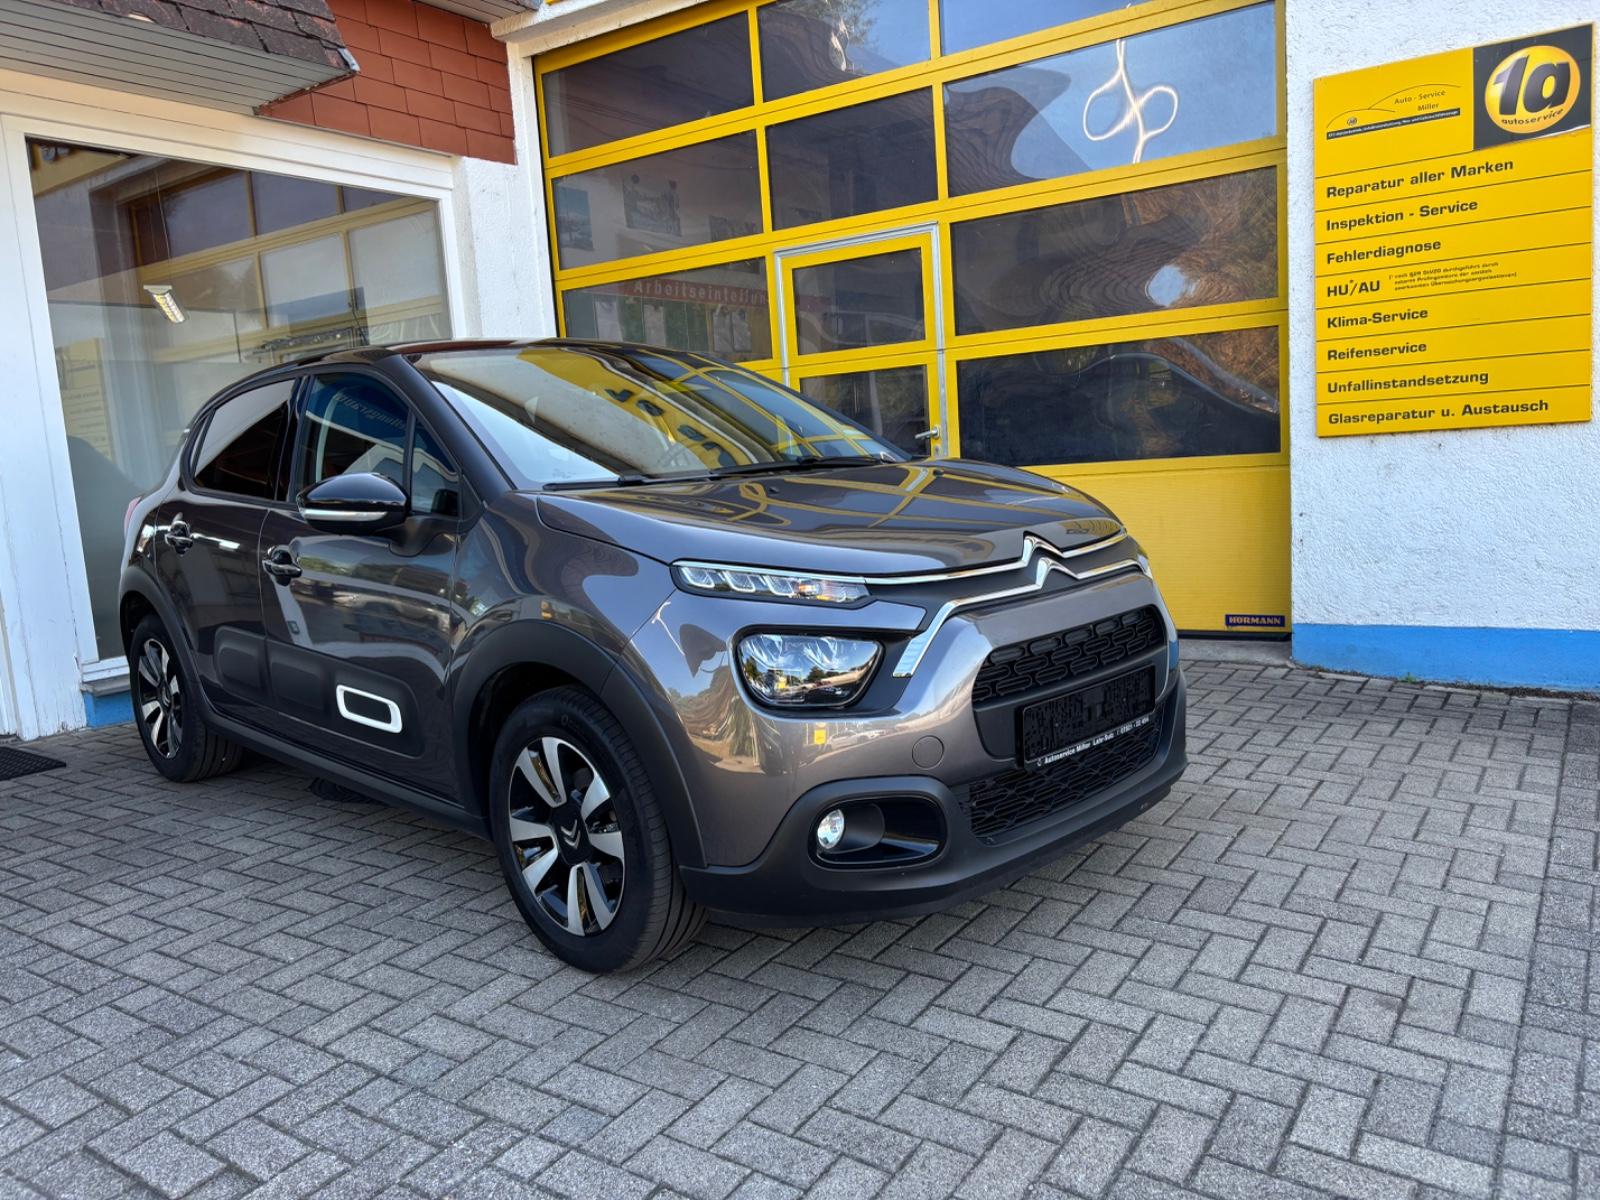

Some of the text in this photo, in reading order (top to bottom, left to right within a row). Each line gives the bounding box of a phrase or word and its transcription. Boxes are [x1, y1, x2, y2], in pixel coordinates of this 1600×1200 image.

[1394, 96, 1413, 105] Auto
[1418, 89, 1446, 101] Service
[1417, 102, 1440, 112] Miller
[1501, 107, 1565, 126] autoservice
[1326, 159, 1514, 199] Reparatur aller Marken
[1326, 210, 1404, 231] Inspektion
[1419, 200, 1478, 218] Service
[1327, 240, 1442, 265] Fehlerdiagnose
[633, 278, 768, 306] Arbeitseinteilun
[1327, 308, 1428, 329] Klima-Service
[1327, 342, 1427, 361] Reifenservice
[1327, 371, 1489, 394] Unfallinstandsetzung
[1328, 399, 1549, 426] Glasreparatur u. Austausch
